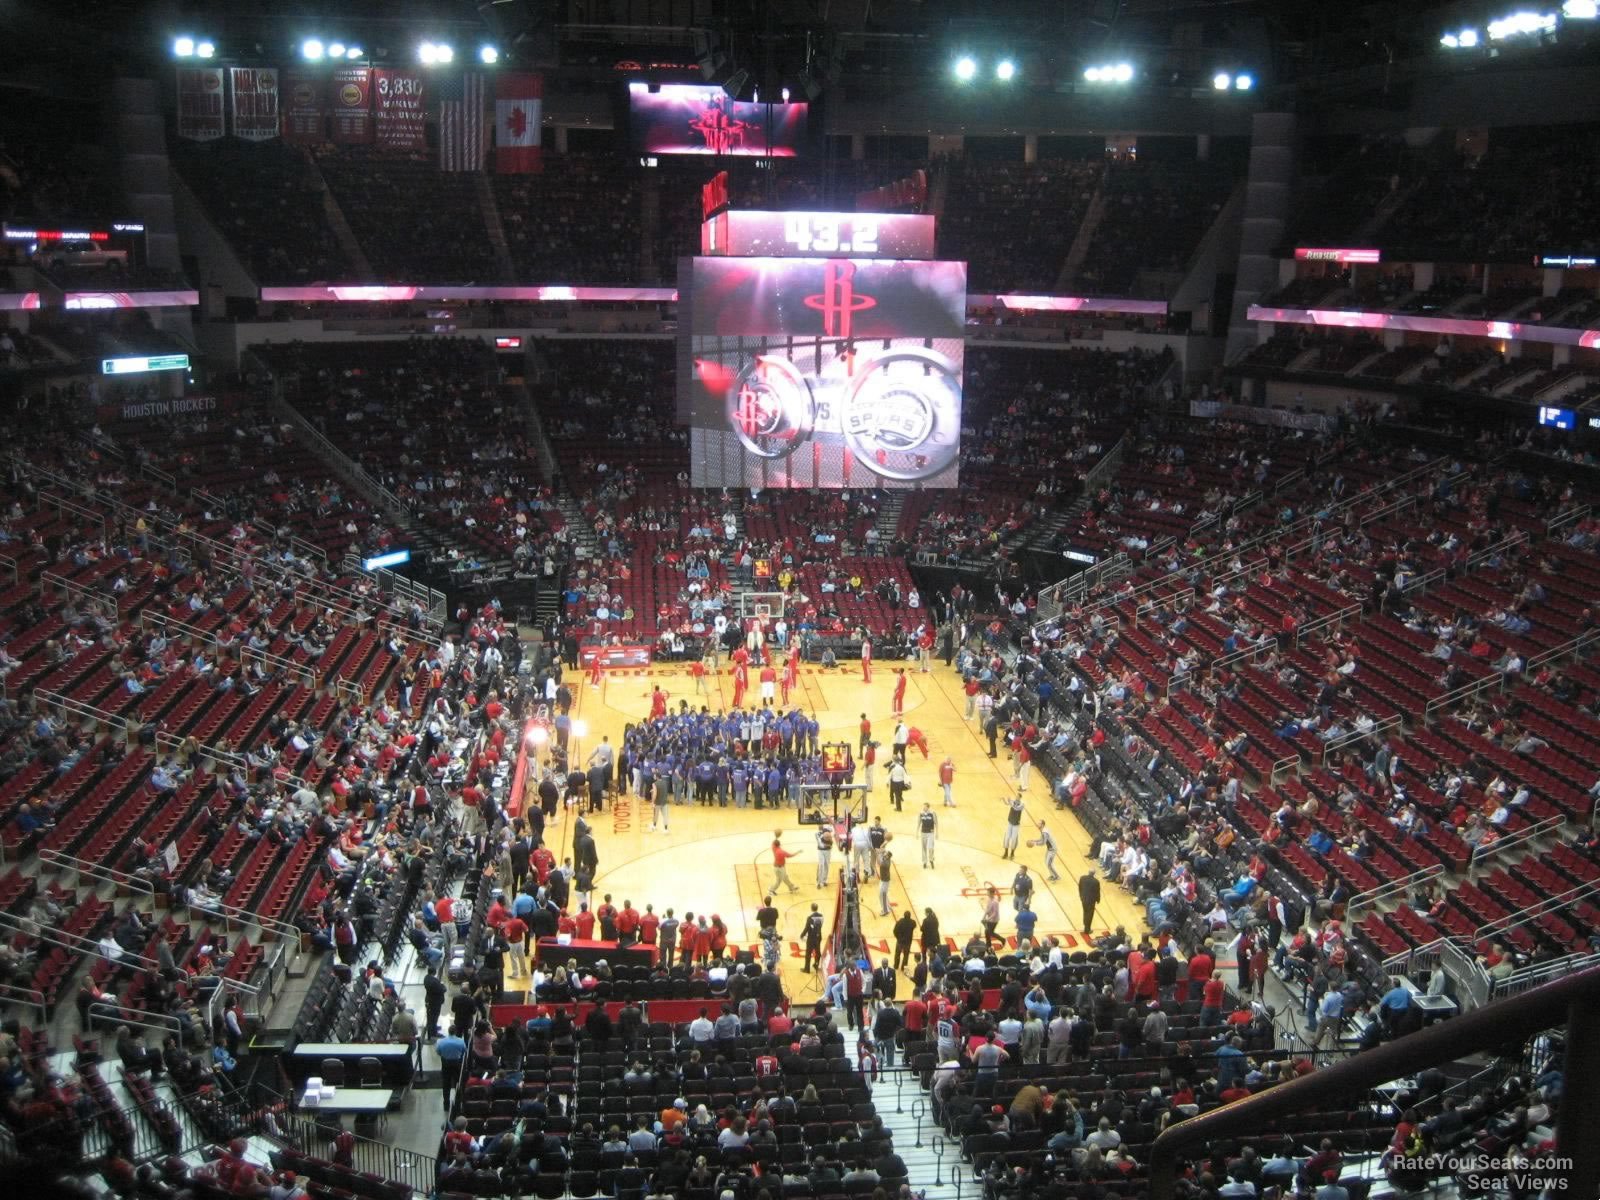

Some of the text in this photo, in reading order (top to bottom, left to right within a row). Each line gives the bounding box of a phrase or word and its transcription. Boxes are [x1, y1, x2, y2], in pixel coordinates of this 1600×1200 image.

[784, 214, 878, 252] 43.2
[123, 398, 216, 418] HOUSTON ROCKETS
[613, 800, 631, 834] TOYOTA
